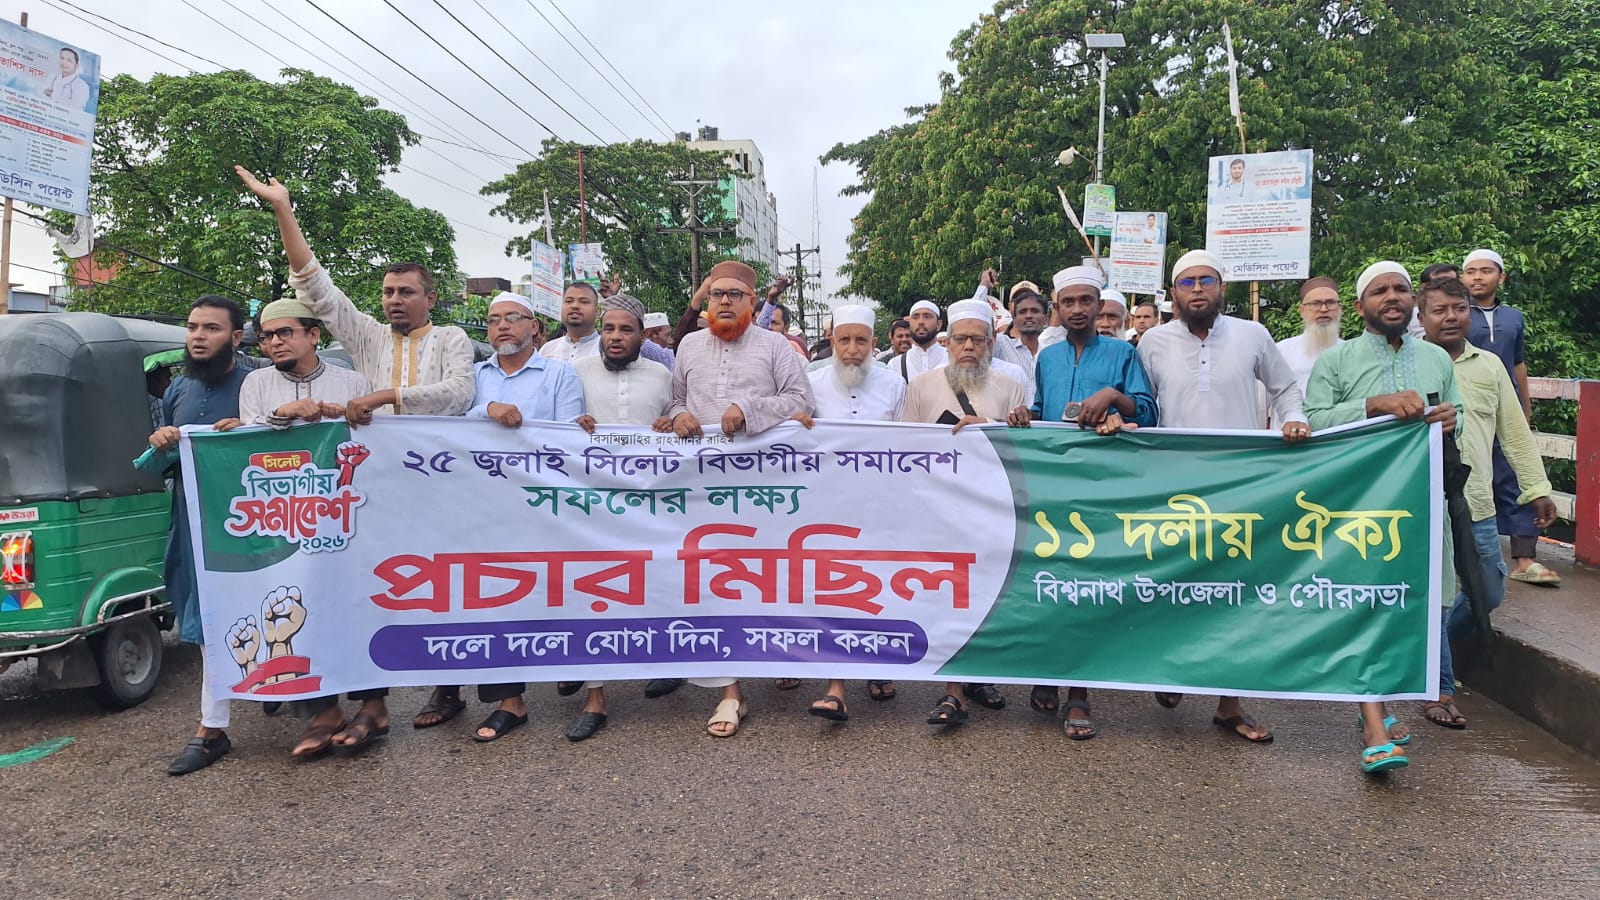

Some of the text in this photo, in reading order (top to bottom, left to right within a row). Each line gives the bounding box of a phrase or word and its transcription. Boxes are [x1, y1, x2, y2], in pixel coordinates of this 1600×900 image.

[38, 183, 74, 199] পয়েন্ট
[1233, 261, 1299, 273] মেডিসিন পয়েন্ট
[590, 433, 650, 446] বিসমিল্লাহির
[262, 455, 301, 470] সিলেট
[403, 443, 962, 479] ২৫ জুলাই সিলেট বিভাগীয় সমাবেশ
[247, 467, 335, 498] বিভাগীয়
[230, 491, 361, 539] সমাবেশ
[521, 485, 808, 516] সফলের লক্ষ্য
[1034, 490, 1413, 562] ১১ দলীয় ঐক্য
[302, 535, 345, 551] ২০২৬
[369, 522, 977, 616] প্রচার মিছিল
[1033, 570, 1411, 610] বিশ্বনাথ উপজেলা ও পৌরসভা
[422, 619, 915, 661] দলে দলে যোগ দিন, সফল করুন
